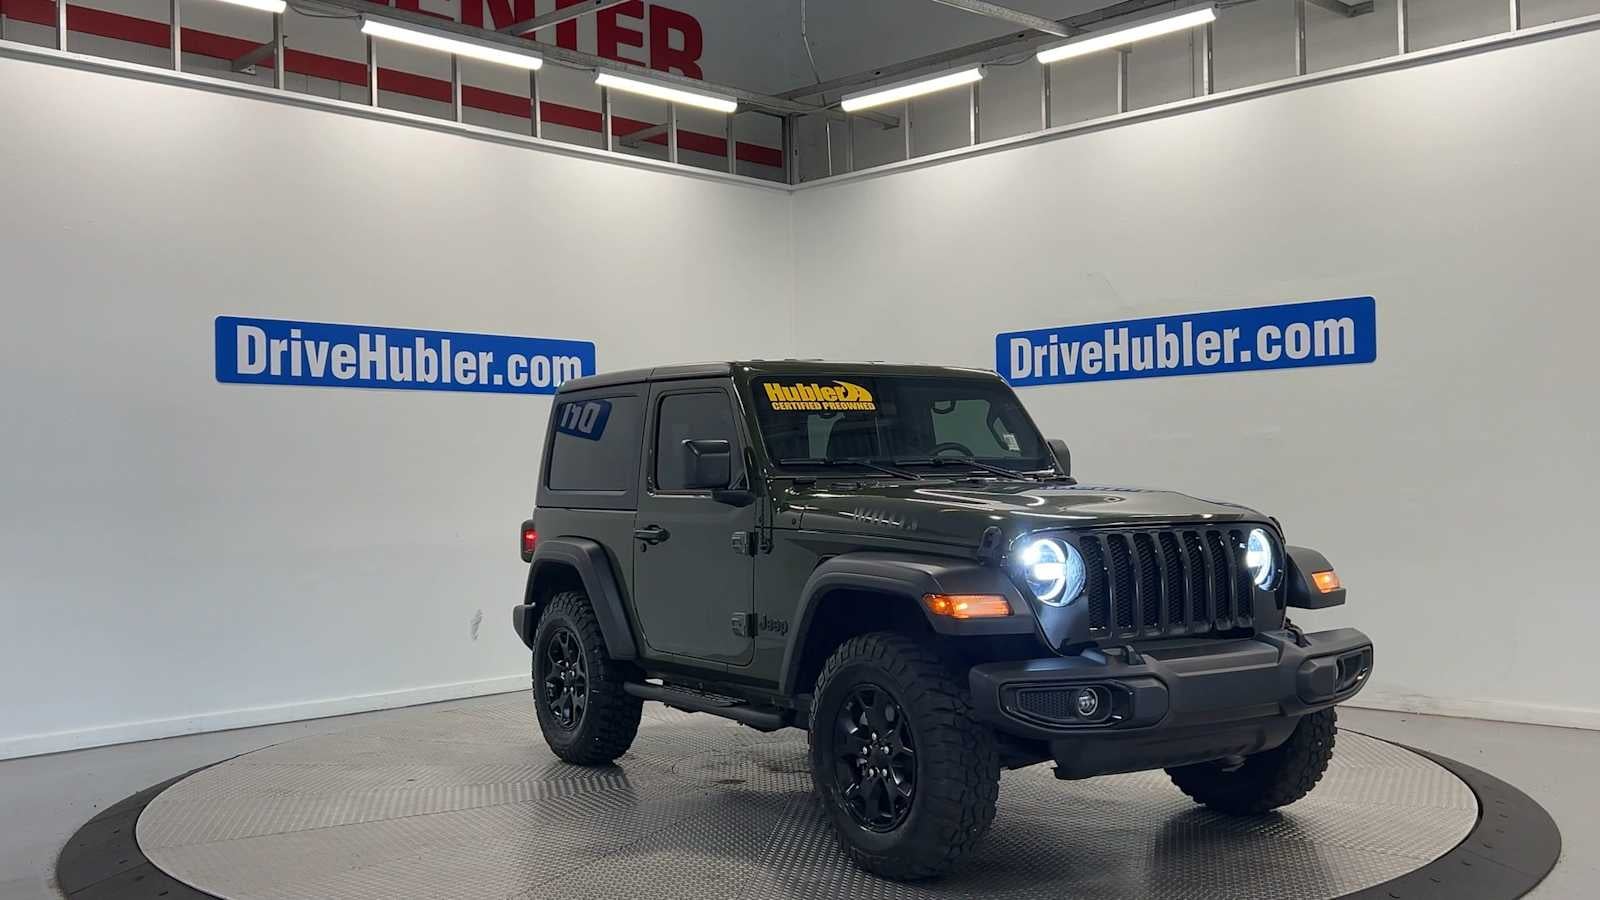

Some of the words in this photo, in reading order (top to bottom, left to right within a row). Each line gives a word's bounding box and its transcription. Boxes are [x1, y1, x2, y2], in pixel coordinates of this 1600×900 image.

[364, 0, 703, 81] NTER
[237, 325, 582, 387] DriveHubler.com
[1010, 316, 1354, 379] DriveHubler.com
[764, 383, 848, 401] Hubler
[772, 402, 822, 410] CERTIFIED
[822, 402, 876, 411] PREOWNED
[759, 615, 789, 636] Jeep
